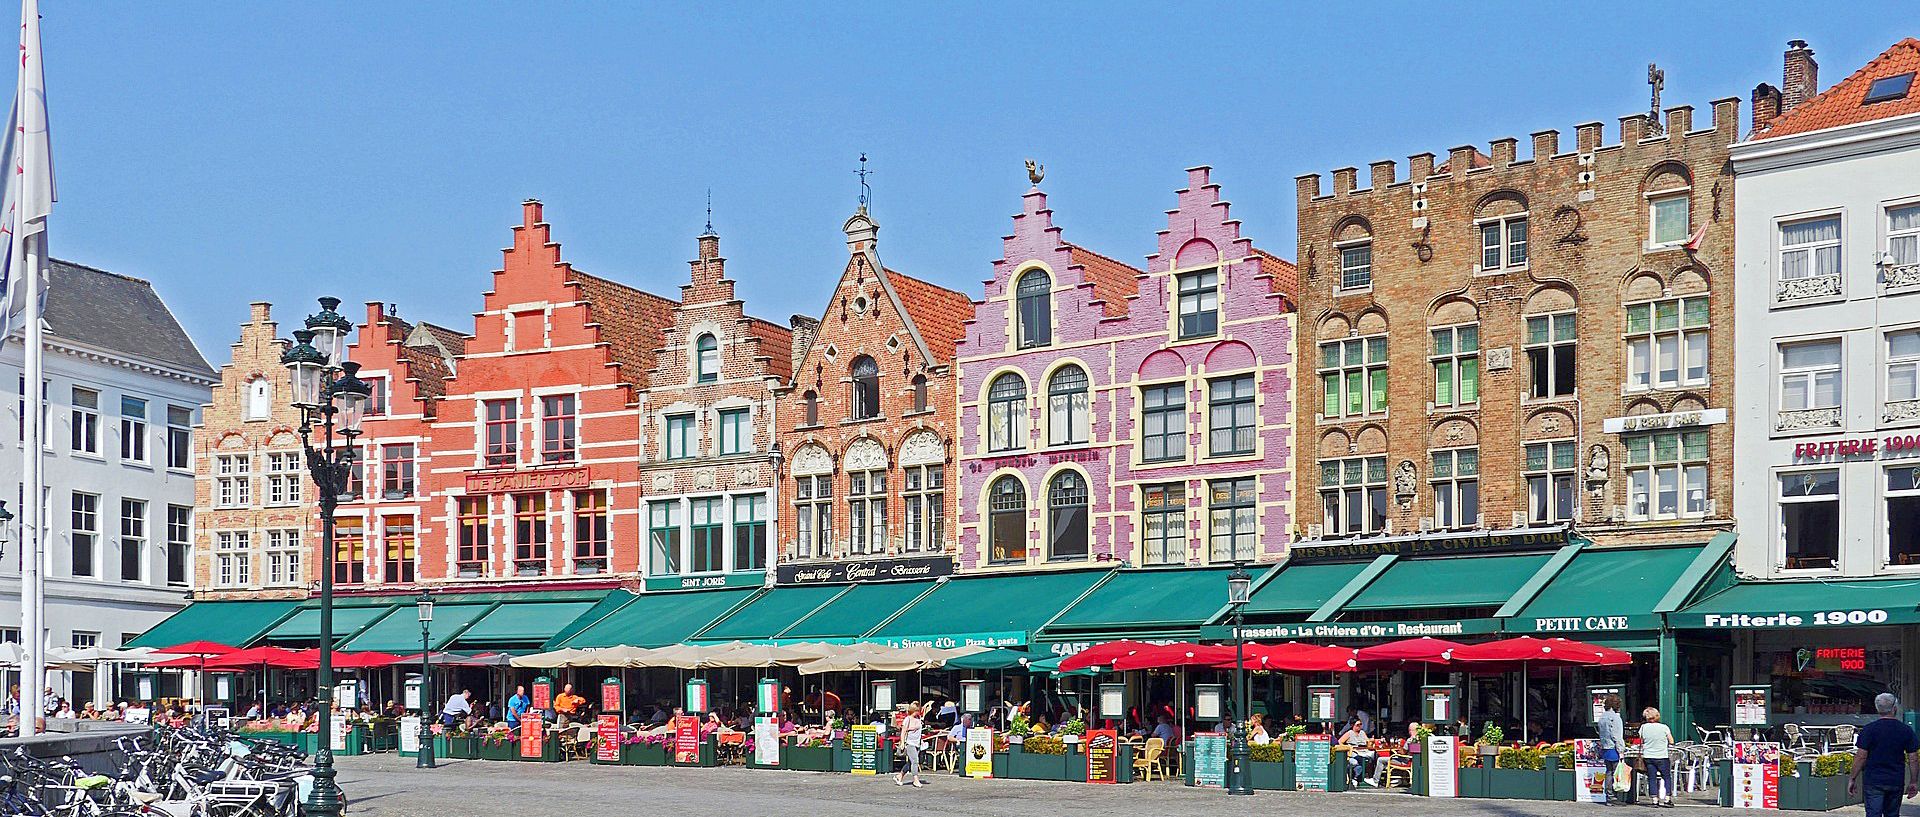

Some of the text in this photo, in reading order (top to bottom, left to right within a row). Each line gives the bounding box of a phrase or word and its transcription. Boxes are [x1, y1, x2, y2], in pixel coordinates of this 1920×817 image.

[1795, 438, 1877, 458] FRITERIE
[471, 479, 489, 491] LE
[493, 473, 546, 490] PANIER
[1295, 543, 1401, 558] RESTAURANT
[846, 563, 877, 581] Central
[891, 564, 931, 576] Brasserie
[682, 577, 725, 588] SINT JORIS
[1535, 616, 1629, 631] PETIT CAFE
[1705, 609, 1888, 627] Friterie 1900
[1298, 627, 1313, 637] La
[1315, 626, 1358, 636] Civiere
[1398, 622, 1463, 636] Restaurant
[998, 638, 1018, 647] pasta
[1816, 648, 1865, 658] FRITERIE
[1841, 659, 1865, 669] 1900
